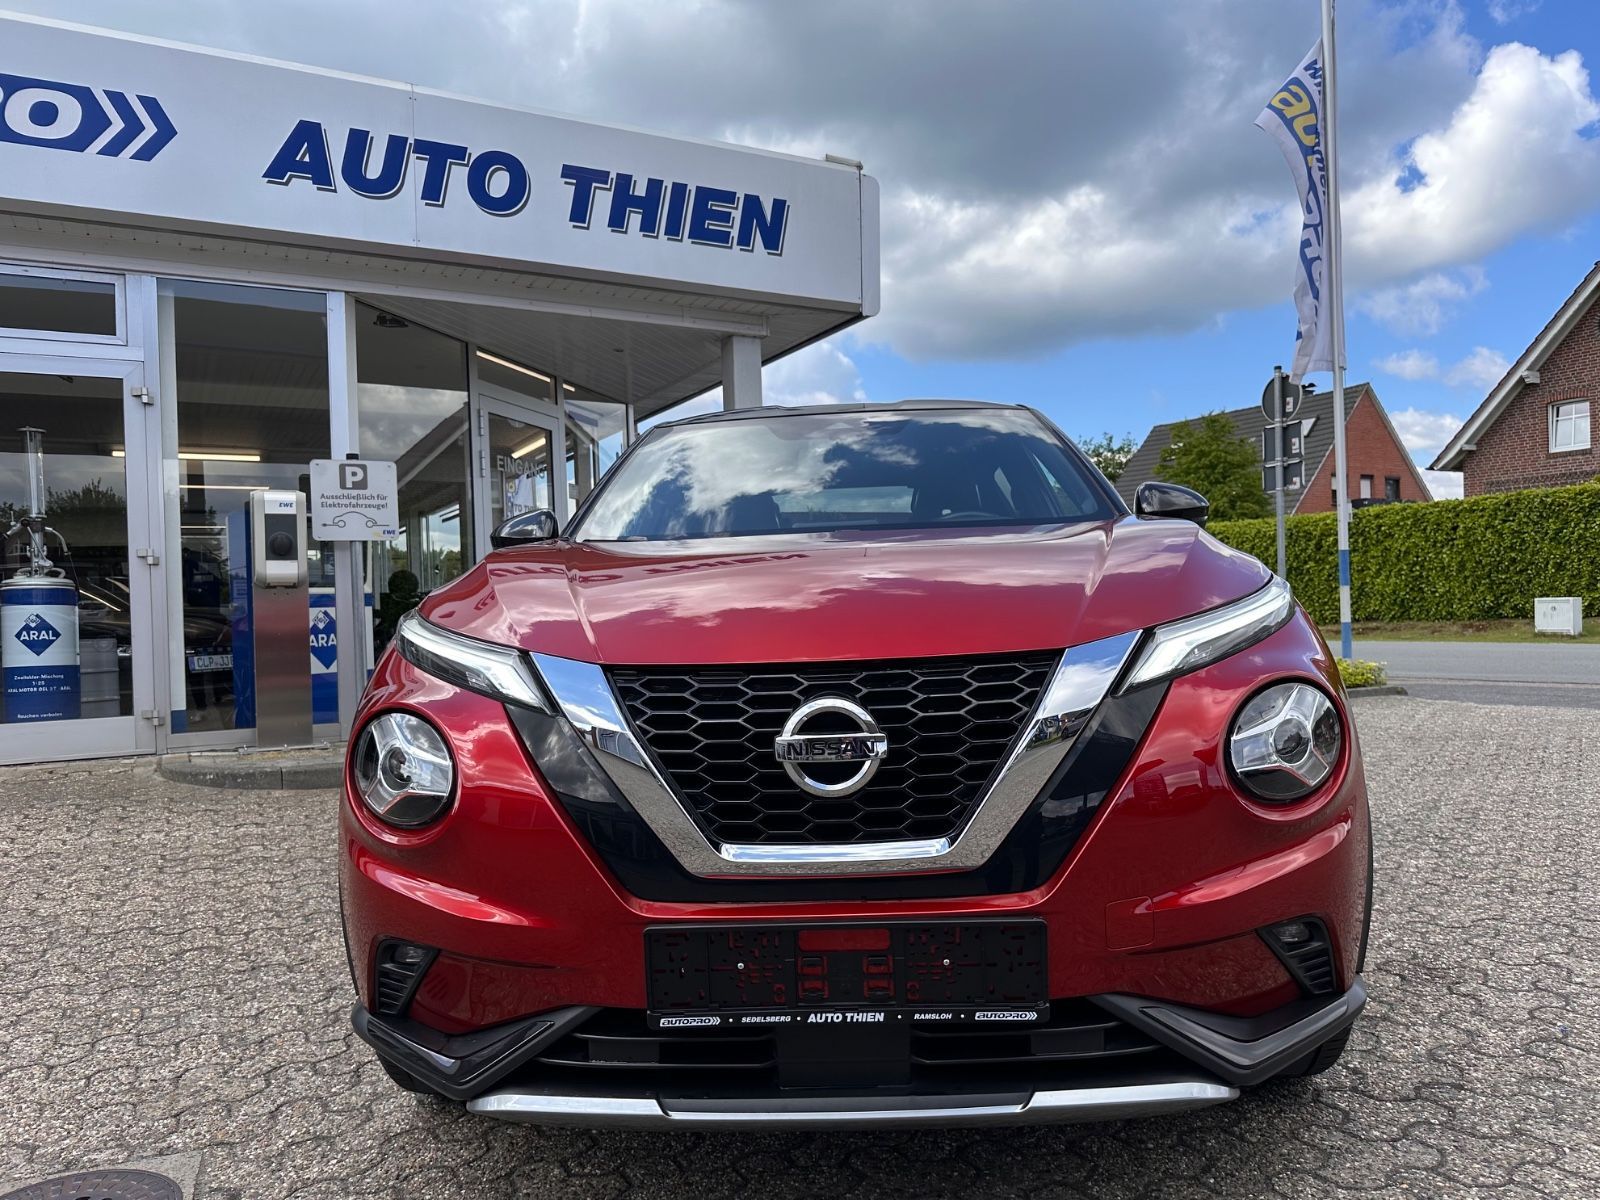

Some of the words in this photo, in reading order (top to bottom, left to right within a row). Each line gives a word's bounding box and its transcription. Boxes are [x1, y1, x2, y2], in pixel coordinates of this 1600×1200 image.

[0, 86, 83, 140] O
[261, 119, 531, 217] AUTO
[560, 163, 790, 257] THIEN
[496, 455, 545, 479] EINGANG
[345, 465, 364, 488] P
[320, 493, 375, 501] Ausschließlich
[376, 493, 388, 501] für
[320, 501, 388, 510] Elektrofahrzeuge!
[20, 630, 57, 641] ARAL
[310, 633, 337, 647] ARA
[786, 739, 877, 758] NISSAN
[741, 1015, 792, 1023] SEDELSBERG
[807, 1012, 843, 1023] AUTO
[845, 1012, 885, 1022] THIEN
